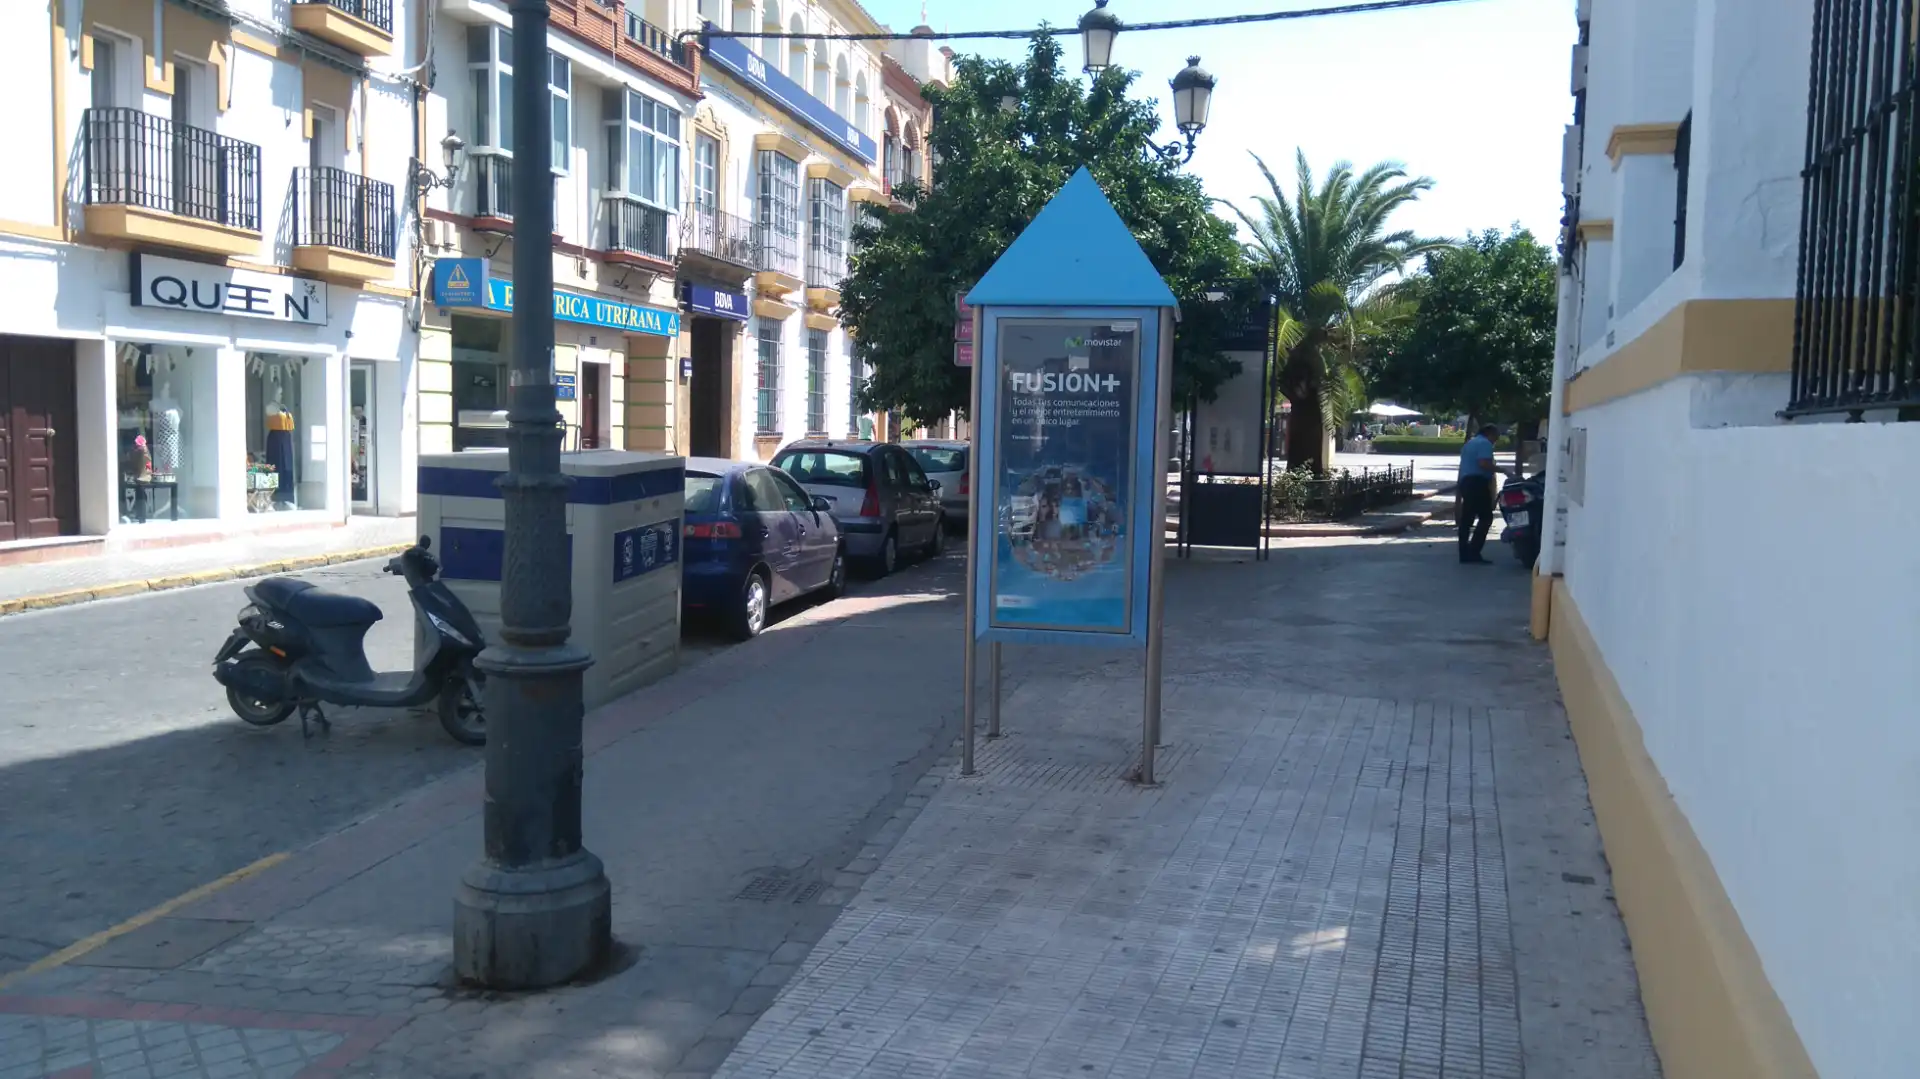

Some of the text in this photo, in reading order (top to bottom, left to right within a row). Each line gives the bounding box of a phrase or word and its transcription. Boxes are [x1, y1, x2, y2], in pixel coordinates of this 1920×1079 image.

[150, 275, 309, 320] QUEEN
[714, 290, 733, 311] BBVA
[596, 302, 662, 331] UTRERANA
[1084, 337, 1122, 347] movistar
[1012, 366, 1121, 393] FUSIÓN+
[1052, 398, 1120, 408] comunicaciones
[1052, 408, 1120, 418] entretenimiento
